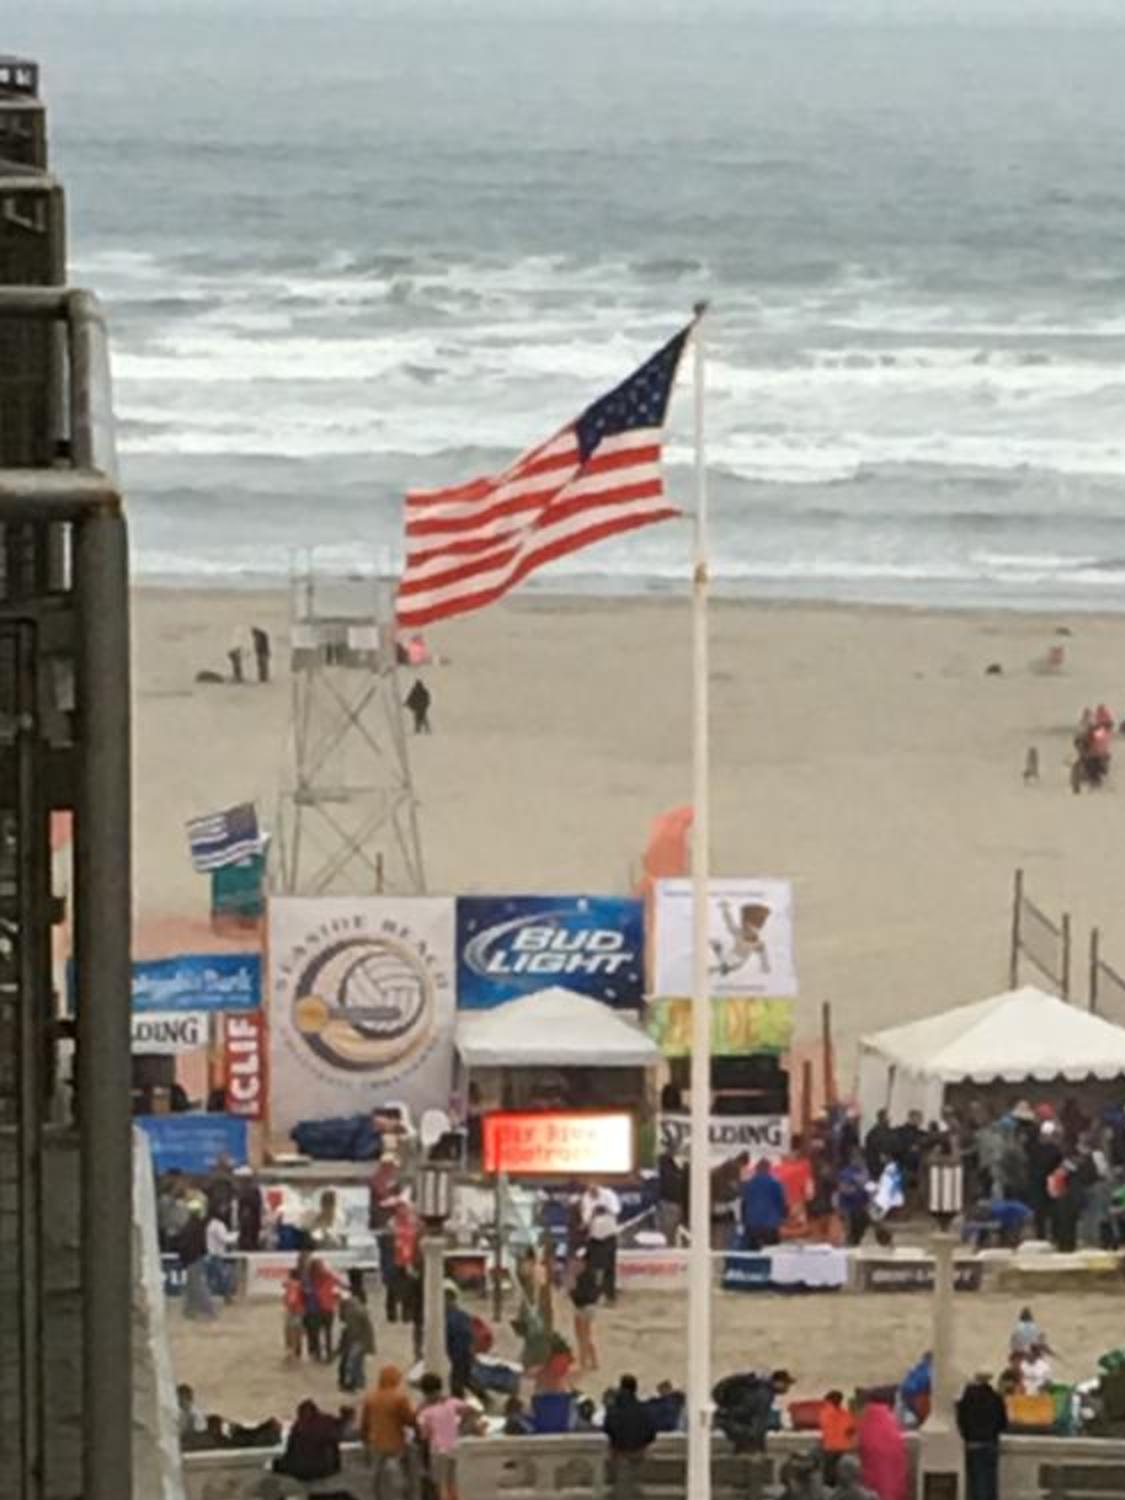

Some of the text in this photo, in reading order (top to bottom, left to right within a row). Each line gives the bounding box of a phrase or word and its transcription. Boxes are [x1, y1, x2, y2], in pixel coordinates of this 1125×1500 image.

[512, 926, 624, 951] BUD
[486, 949, 634, 974] LIGHT
[228, 1017, 260, 1100] CLIF
